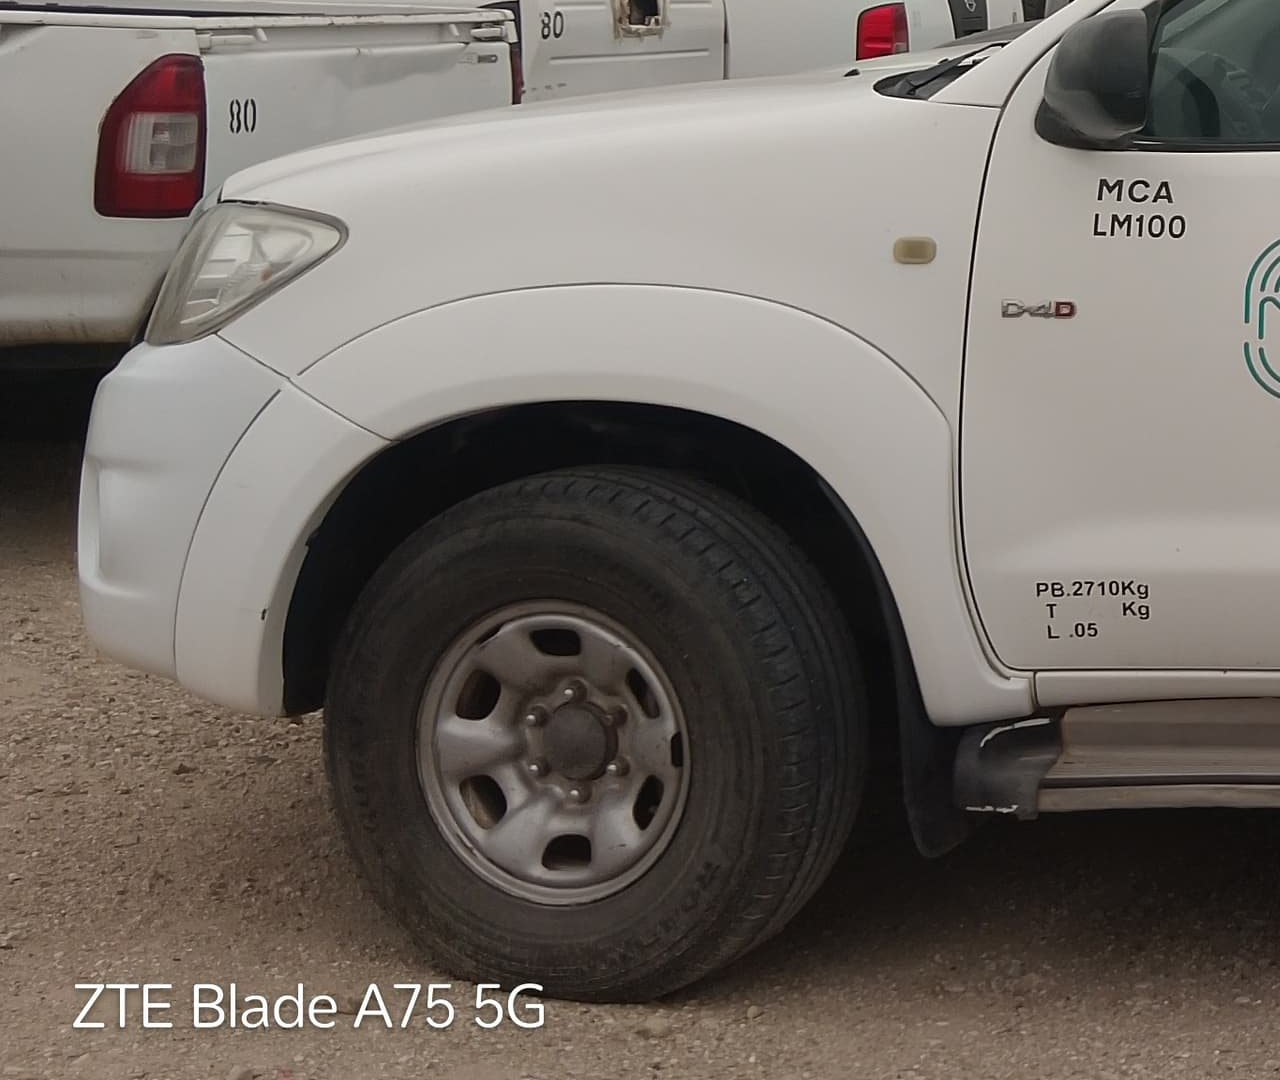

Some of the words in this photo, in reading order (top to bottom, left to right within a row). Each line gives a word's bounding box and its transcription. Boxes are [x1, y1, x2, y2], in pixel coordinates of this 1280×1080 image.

[540, 11, 564, 40] 80
[229, 98, 257, 134] 80
[1096, 178, 1175, 204] MCA
[1092, 212, 1186, 239] LM100
[1045, 603, 1058, 619] T
[1122, 601, 1150, 621] Kg
[1047, 624, 1061, 639] L
